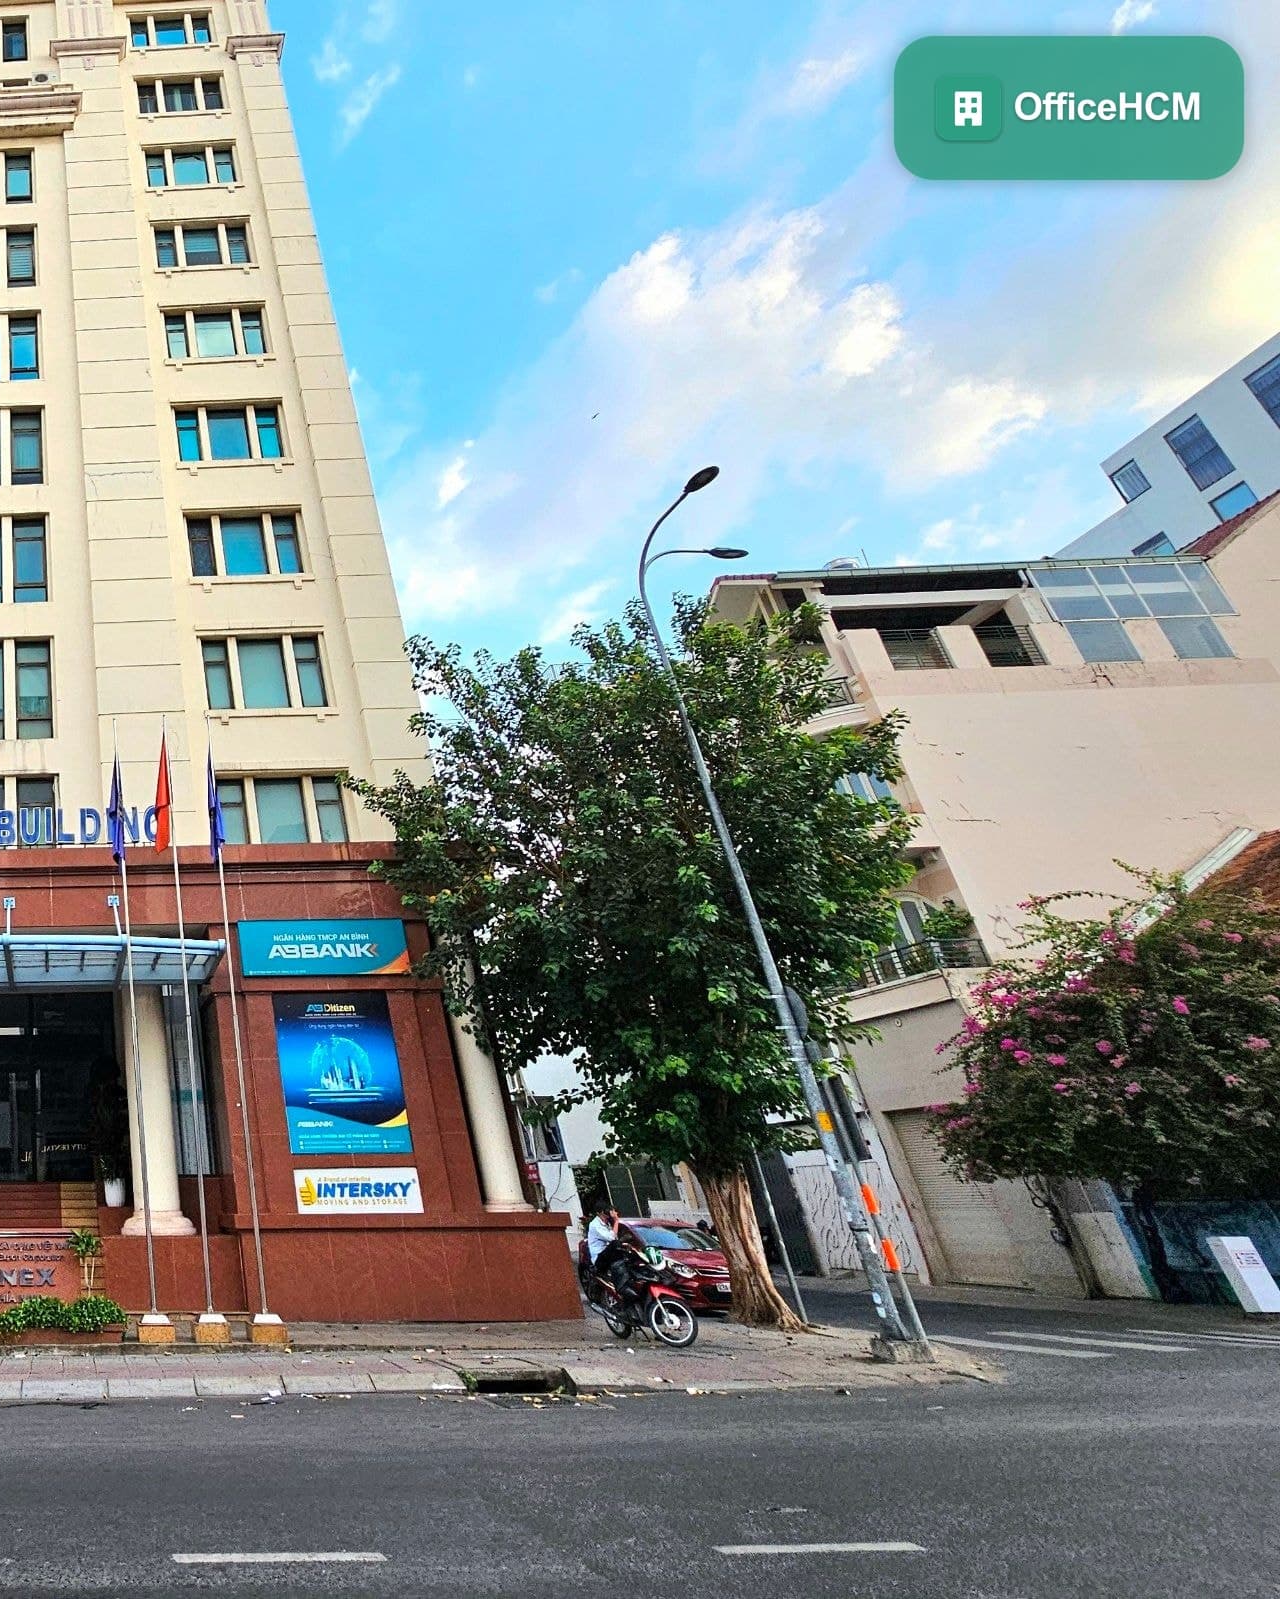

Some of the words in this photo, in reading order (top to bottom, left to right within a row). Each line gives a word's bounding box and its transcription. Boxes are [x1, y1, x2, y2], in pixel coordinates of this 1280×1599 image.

[273, 933, 294, 942] NGÂN
[295, 933, 316, 942] HÀNG
[317, 933, 337, 942] TMCP
[339, 933, 350, 941] AN
[350, 932, 369, 941] BÌNH
[268, 943, 377, 959] ABBANK
[317, 1182, 412, 1198] INTERSKY
